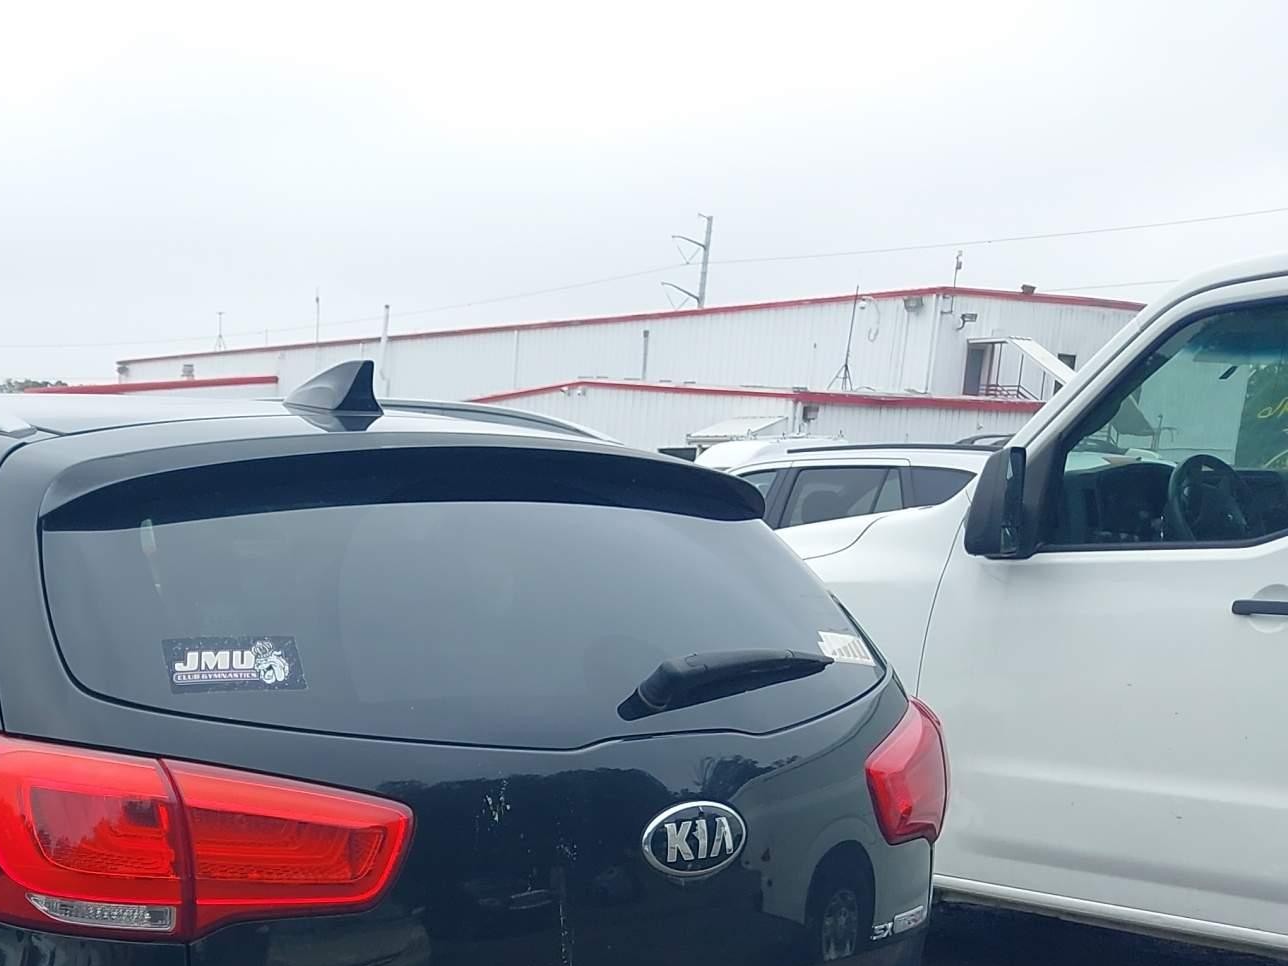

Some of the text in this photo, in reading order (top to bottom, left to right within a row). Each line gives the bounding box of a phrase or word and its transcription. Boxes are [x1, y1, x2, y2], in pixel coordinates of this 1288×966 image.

[174, 650, 255, 672] JMU
[176, 671, 257, 681] CLUB GYMNASTICS
[664, 816, 734, 863] KIA
